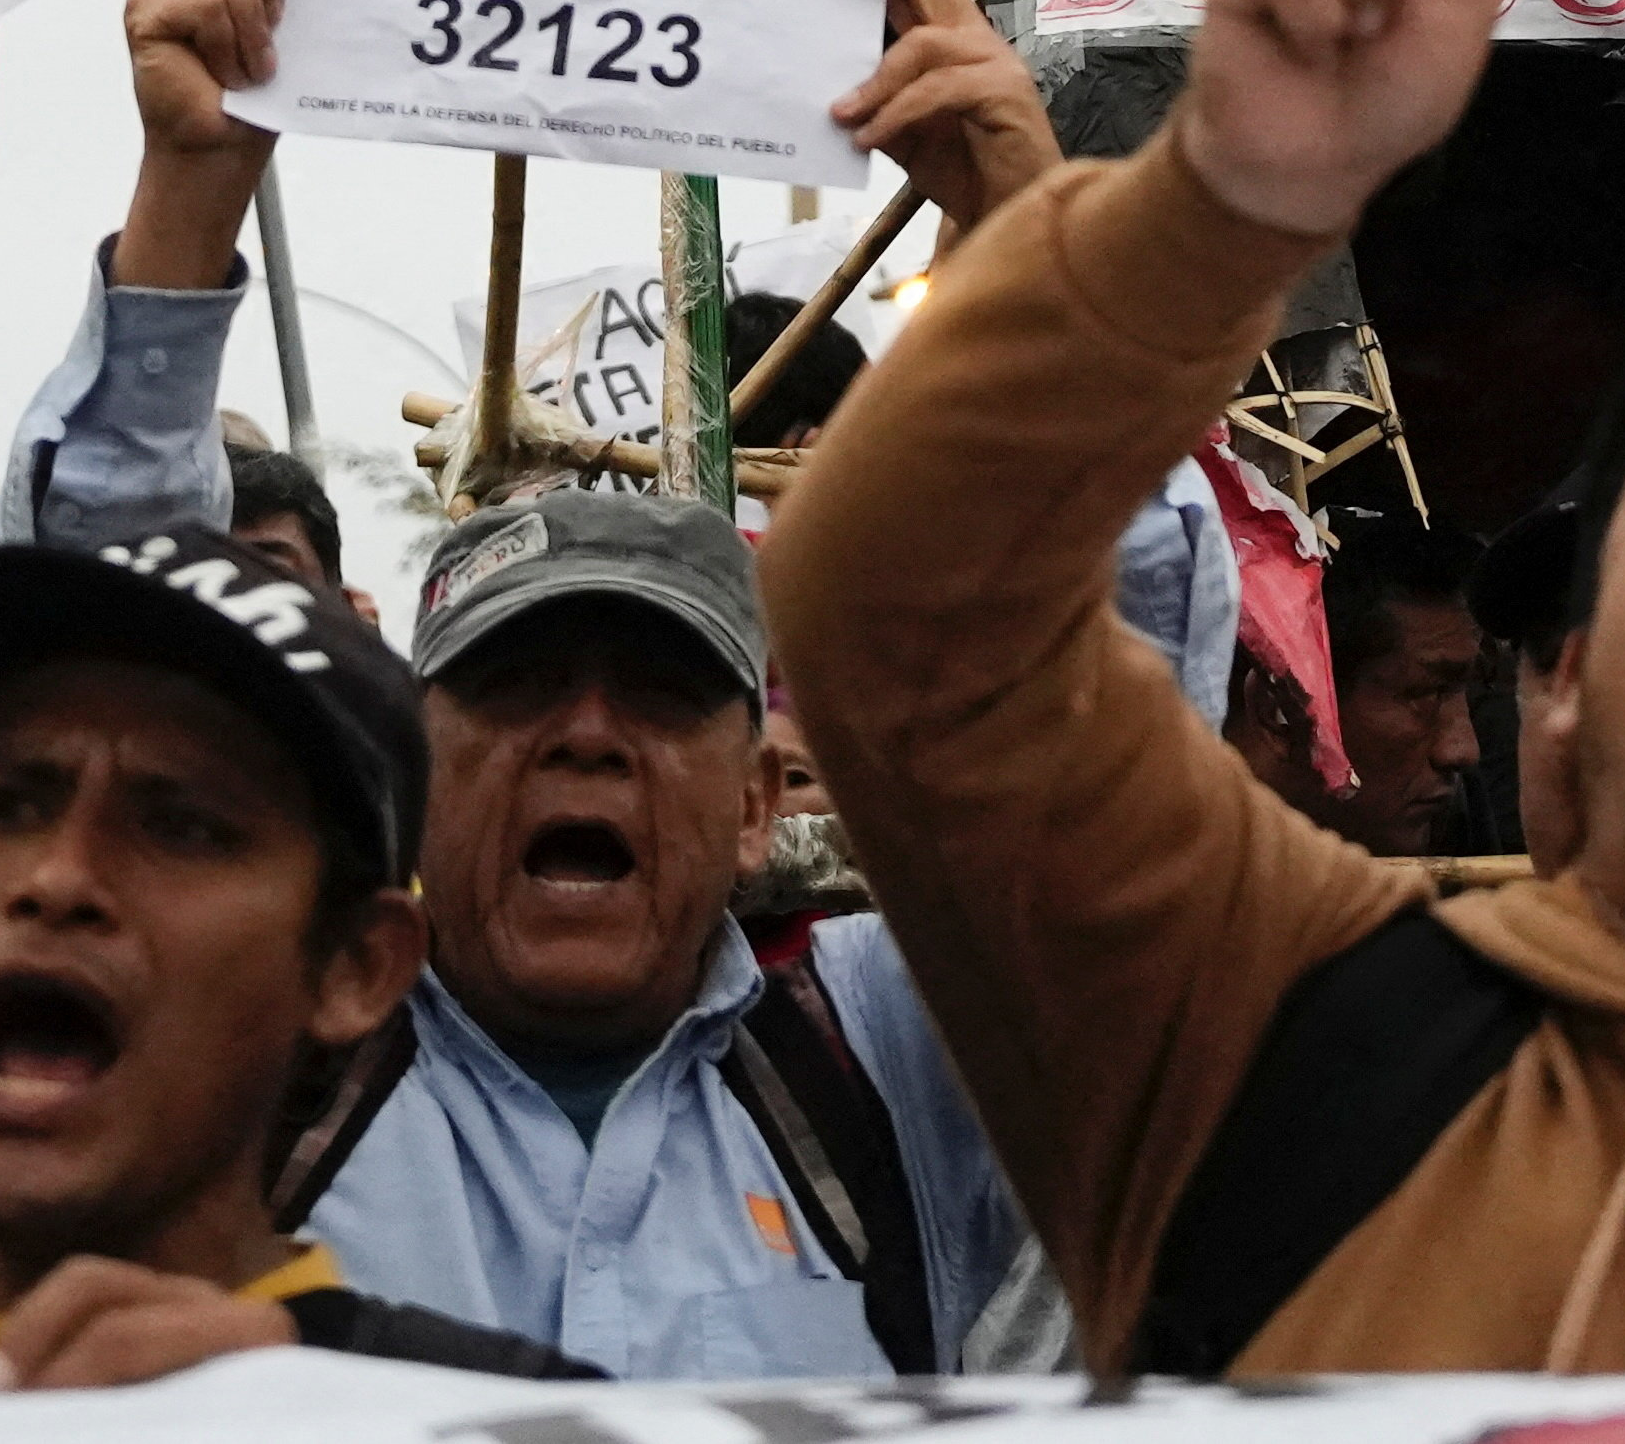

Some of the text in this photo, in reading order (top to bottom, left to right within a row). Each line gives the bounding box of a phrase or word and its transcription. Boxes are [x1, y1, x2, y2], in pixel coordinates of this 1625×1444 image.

[363, 100, 396, 115] POR
[400, 103, 421, 117] LA
[426, 106, 498, 126] DEFENSA
[503, 113, 533, 129] DEL
[540, 116, 616, 137] DERECHO
[698, 132, 726, 148] DEL
[732, 136, 797, 156] PUEBLO
